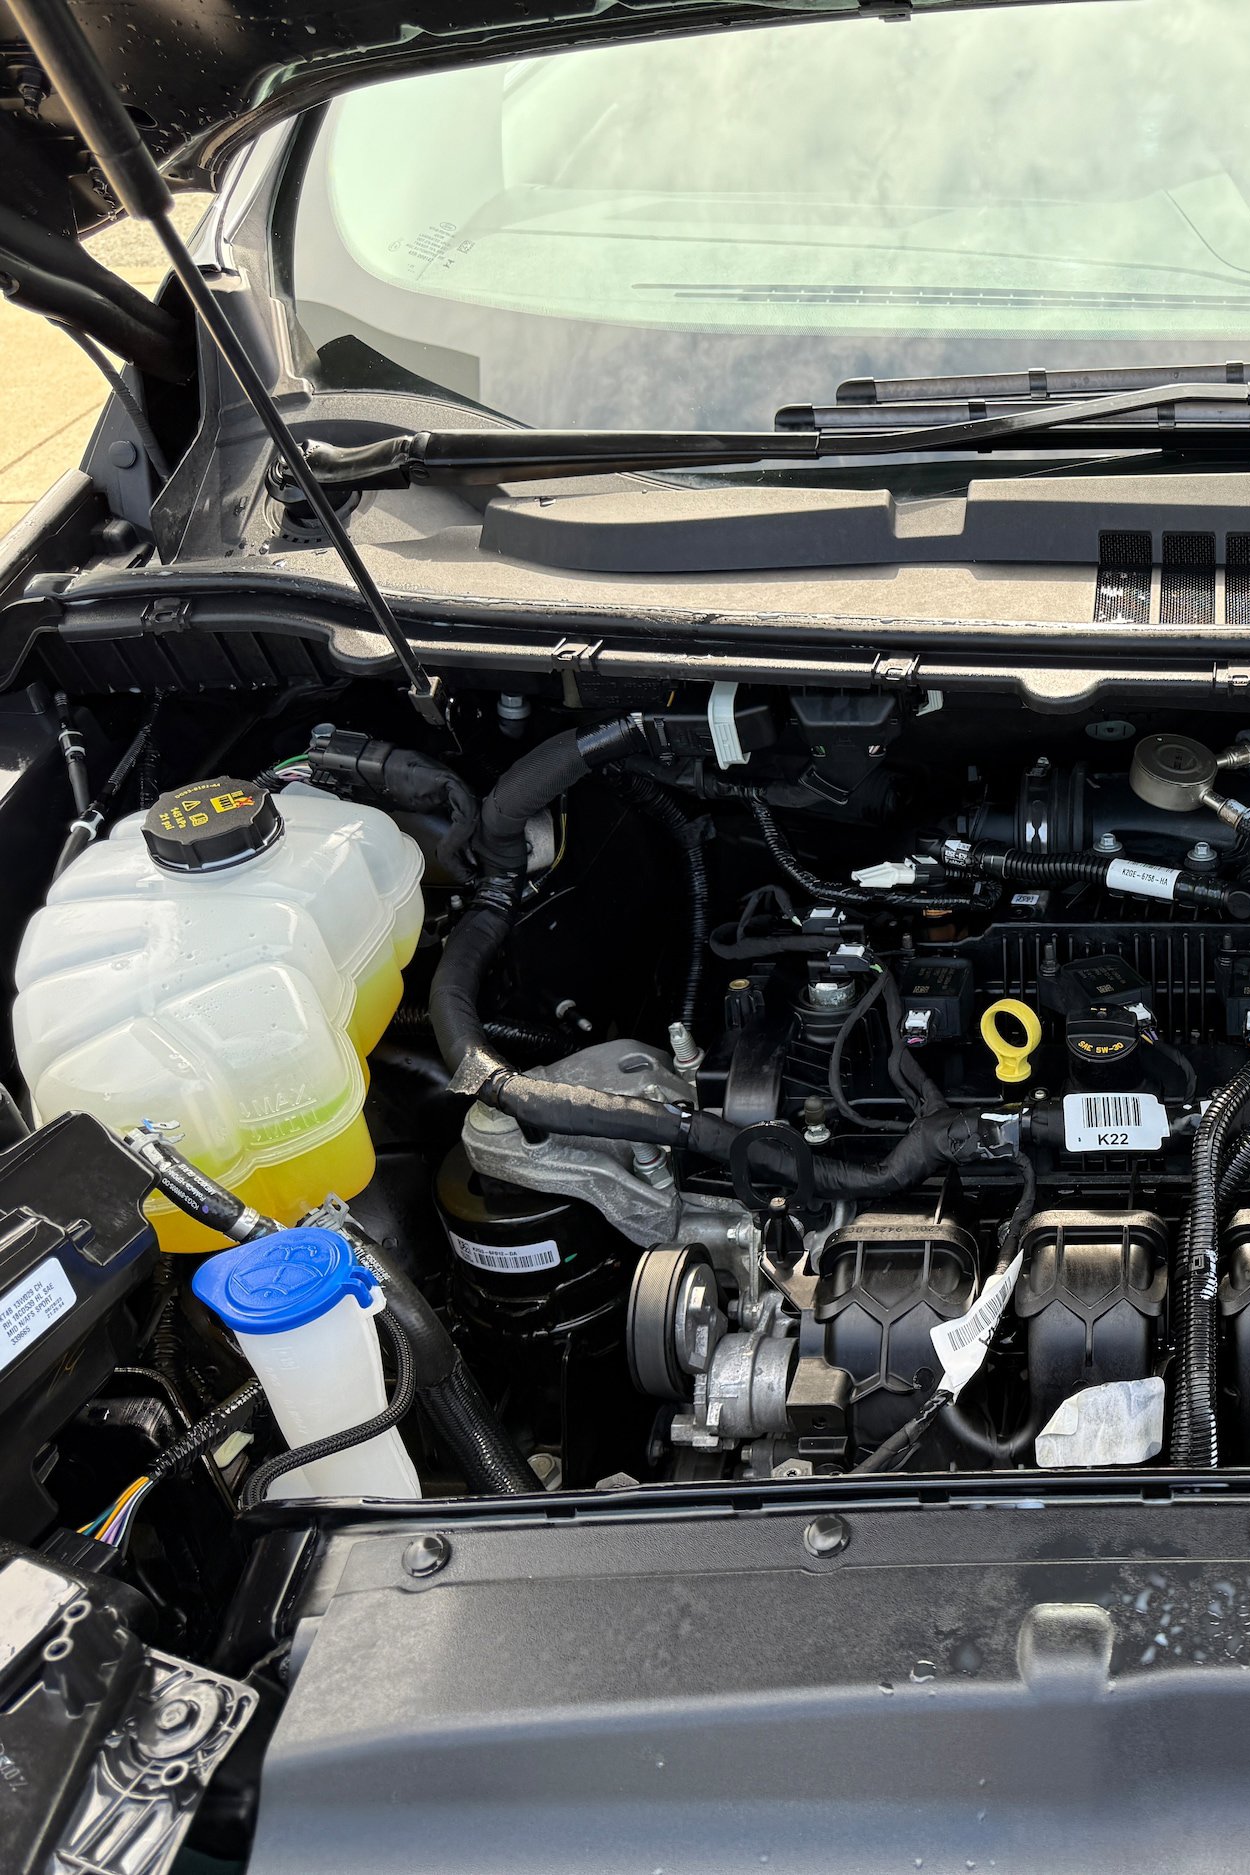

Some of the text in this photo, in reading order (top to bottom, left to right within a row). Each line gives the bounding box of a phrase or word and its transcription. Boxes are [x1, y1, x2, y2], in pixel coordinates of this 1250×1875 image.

[1078, 1040, 1124, 1053] SAE 5W-30
[252, 1084, 312, 1117] MAX
[262, 1108, 321, 1140] MIN
[1098, 1133, 1129, 1145] K22
[35, 1292, 43, 1303] HL
[43, 1282, 54, 1296] SAE
[7, 1325, 19, 1337] MID
[36, 1294, 53, 1313] SPORT
